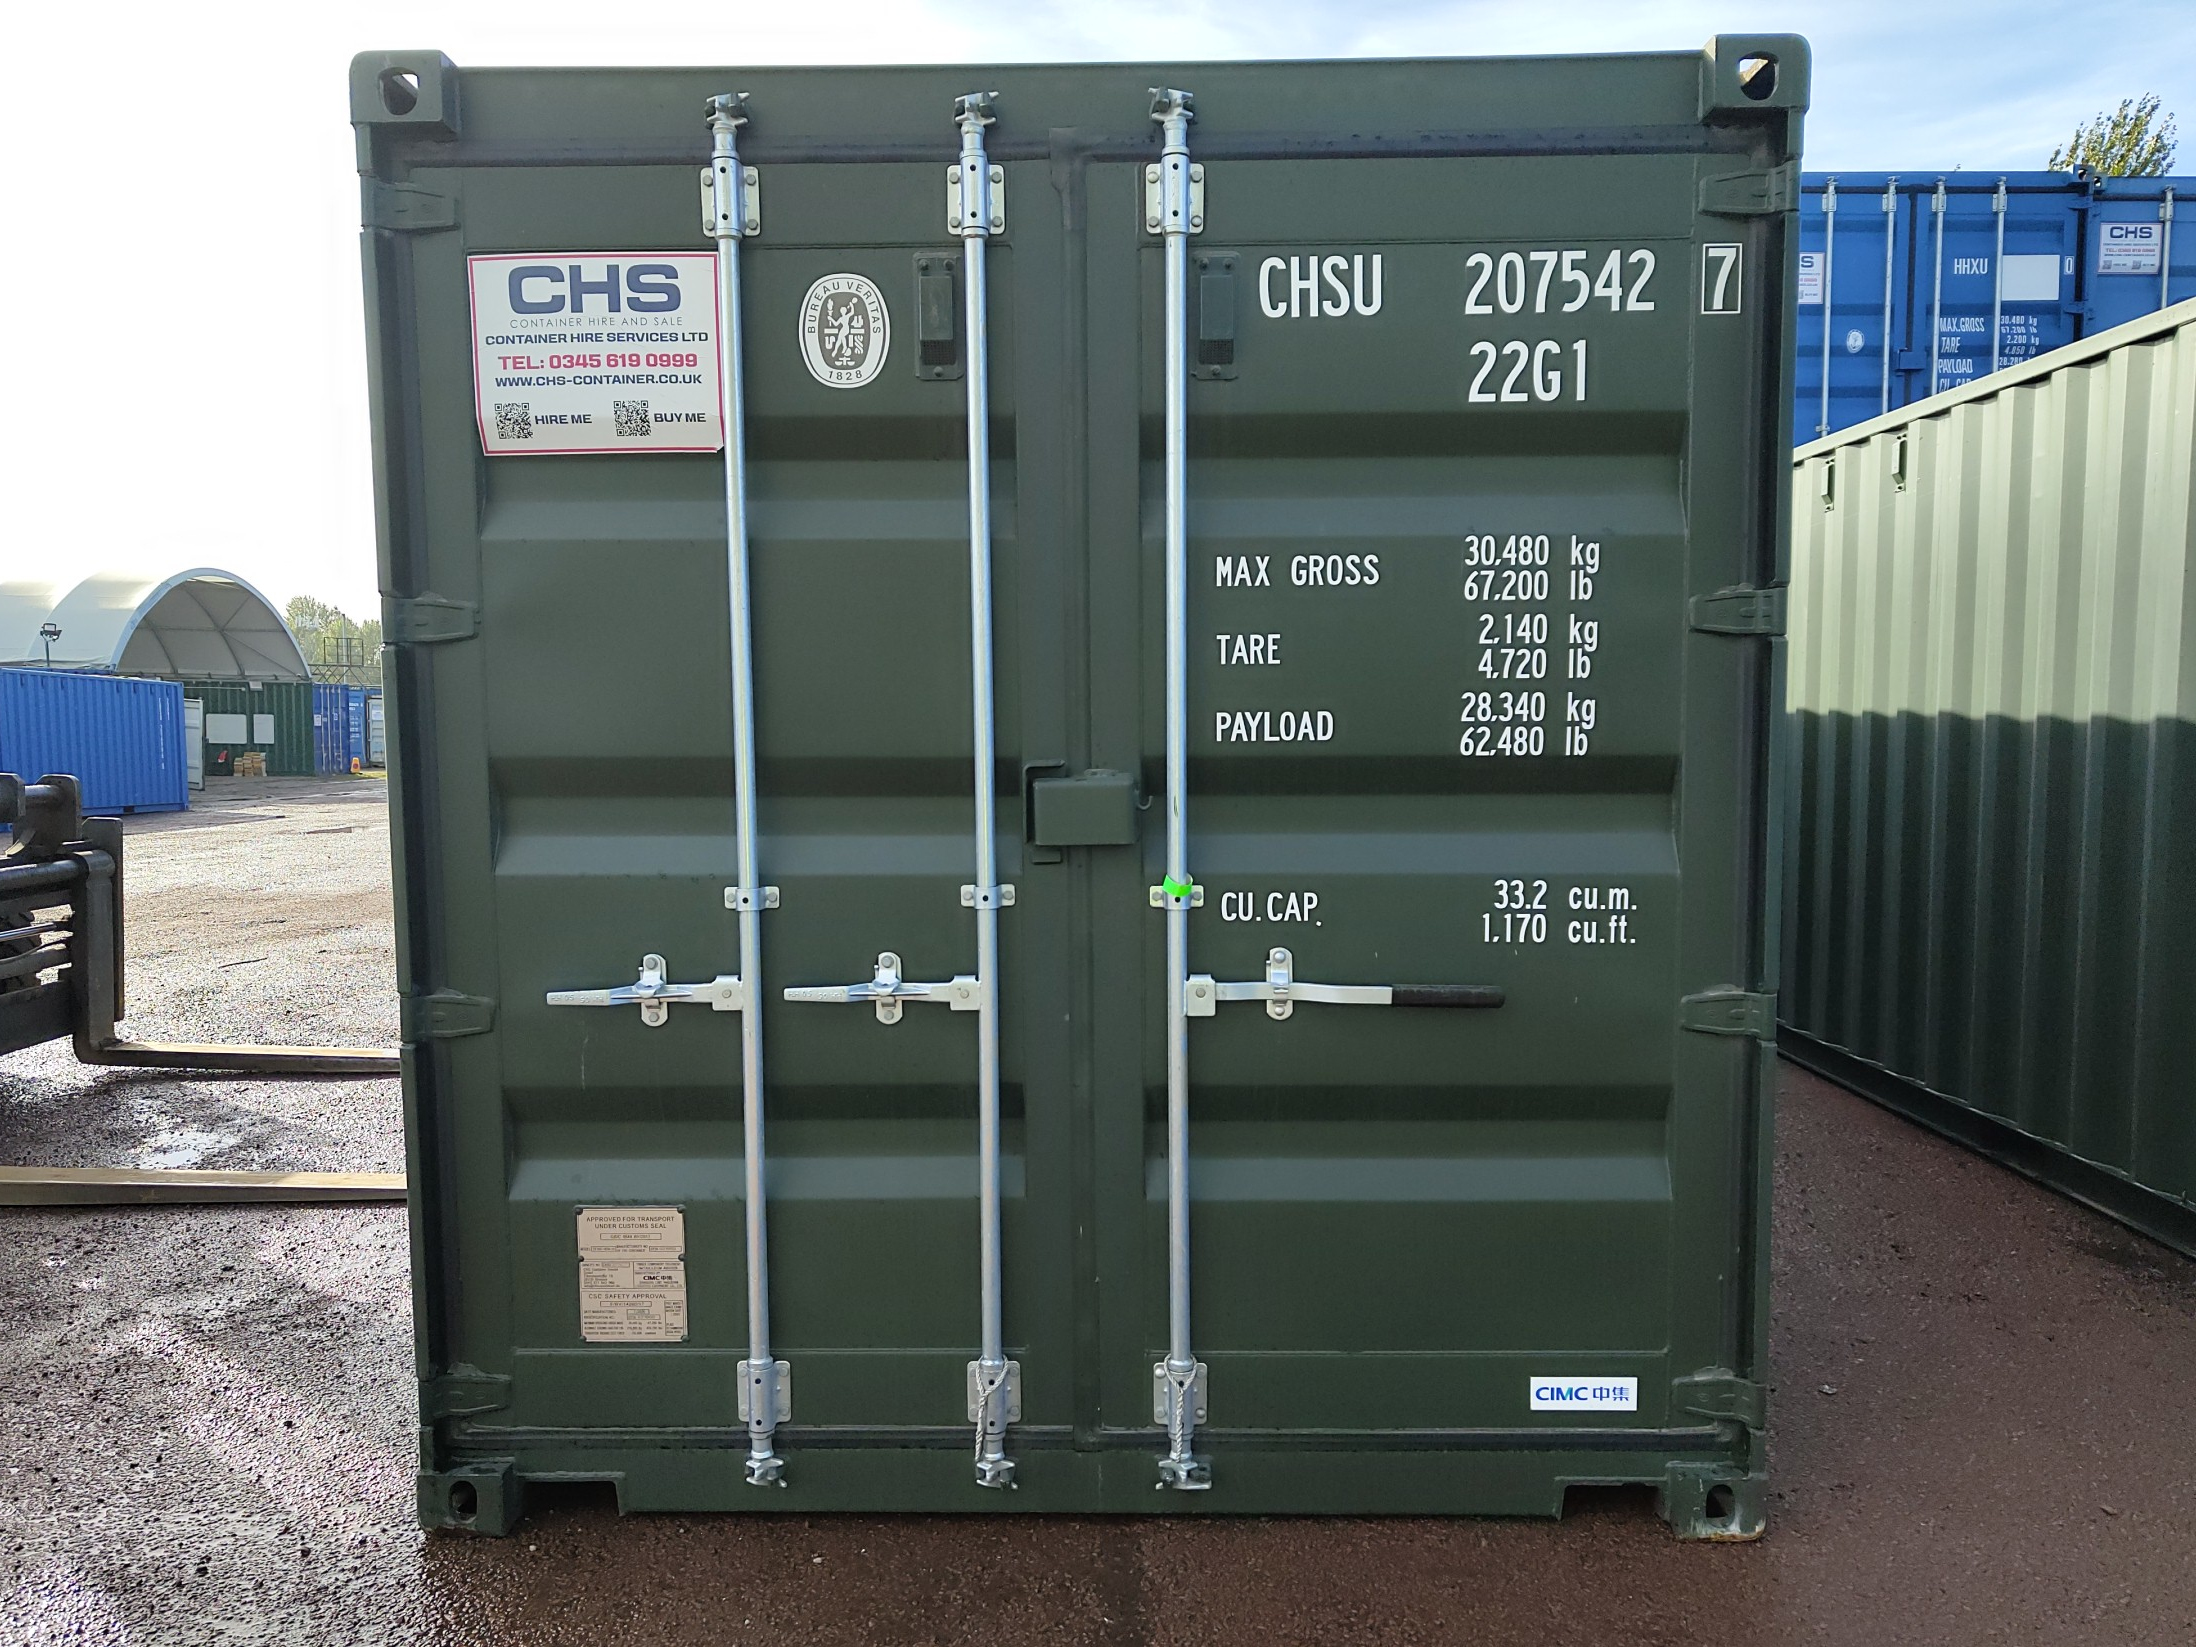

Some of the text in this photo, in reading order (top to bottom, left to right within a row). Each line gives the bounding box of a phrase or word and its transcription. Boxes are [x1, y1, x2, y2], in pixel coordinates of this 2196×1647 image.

[2110, 227, 2152, 238] CHS
[1954, 259, 1987, 274] HHXU
[508, 264, 681, 315] CHS
[1260, 248, 1736, 317] CHSU 207542 7
[808, 282, 881, 333] BUREAU VERITAS
[509, 316, 684, 329] CONTAINER HIRE AND SALE
[486, 333, 708, 345] CONTAINER HIRE SERVICES LTD
[1941, 337, 1960, 353] TARE
[498, 354, 697, 370] TEL: 0345 619 0999
[828, 369, 863, 381] 1828
[1469, 340, 1586, 402] 22G1
[1939, 359, 1973, 373] PAYLOAD
[495, 375, 701, 387] WWW.CHS-CONTAINER.CO.UK
[535, 415, 592, 424] HIRE ME
[654, 413, 706, 422] BUY ME
[1571, 535, 1600, 574] kg
[1217, 555, 1379, 586] MAX GROSS
[1570, 570, 1593, 600] lb
[1569, 614, 1598, 652] kg
[1217, 634, 1280, 664] TARE
[1568, 649, 1591, 678] lb
[1567, 692, 1596, 729] kg
[1217, 711, 1333, 741] PAYLOAD
[1565, 727, 1588, 755] lb
[1494, 880, 1636, 910] 33.2 cu.m.
[1568, 915, 1635, 943] cu.ft.
[1535, 1386, 1629, 1401] CIMC 中集
